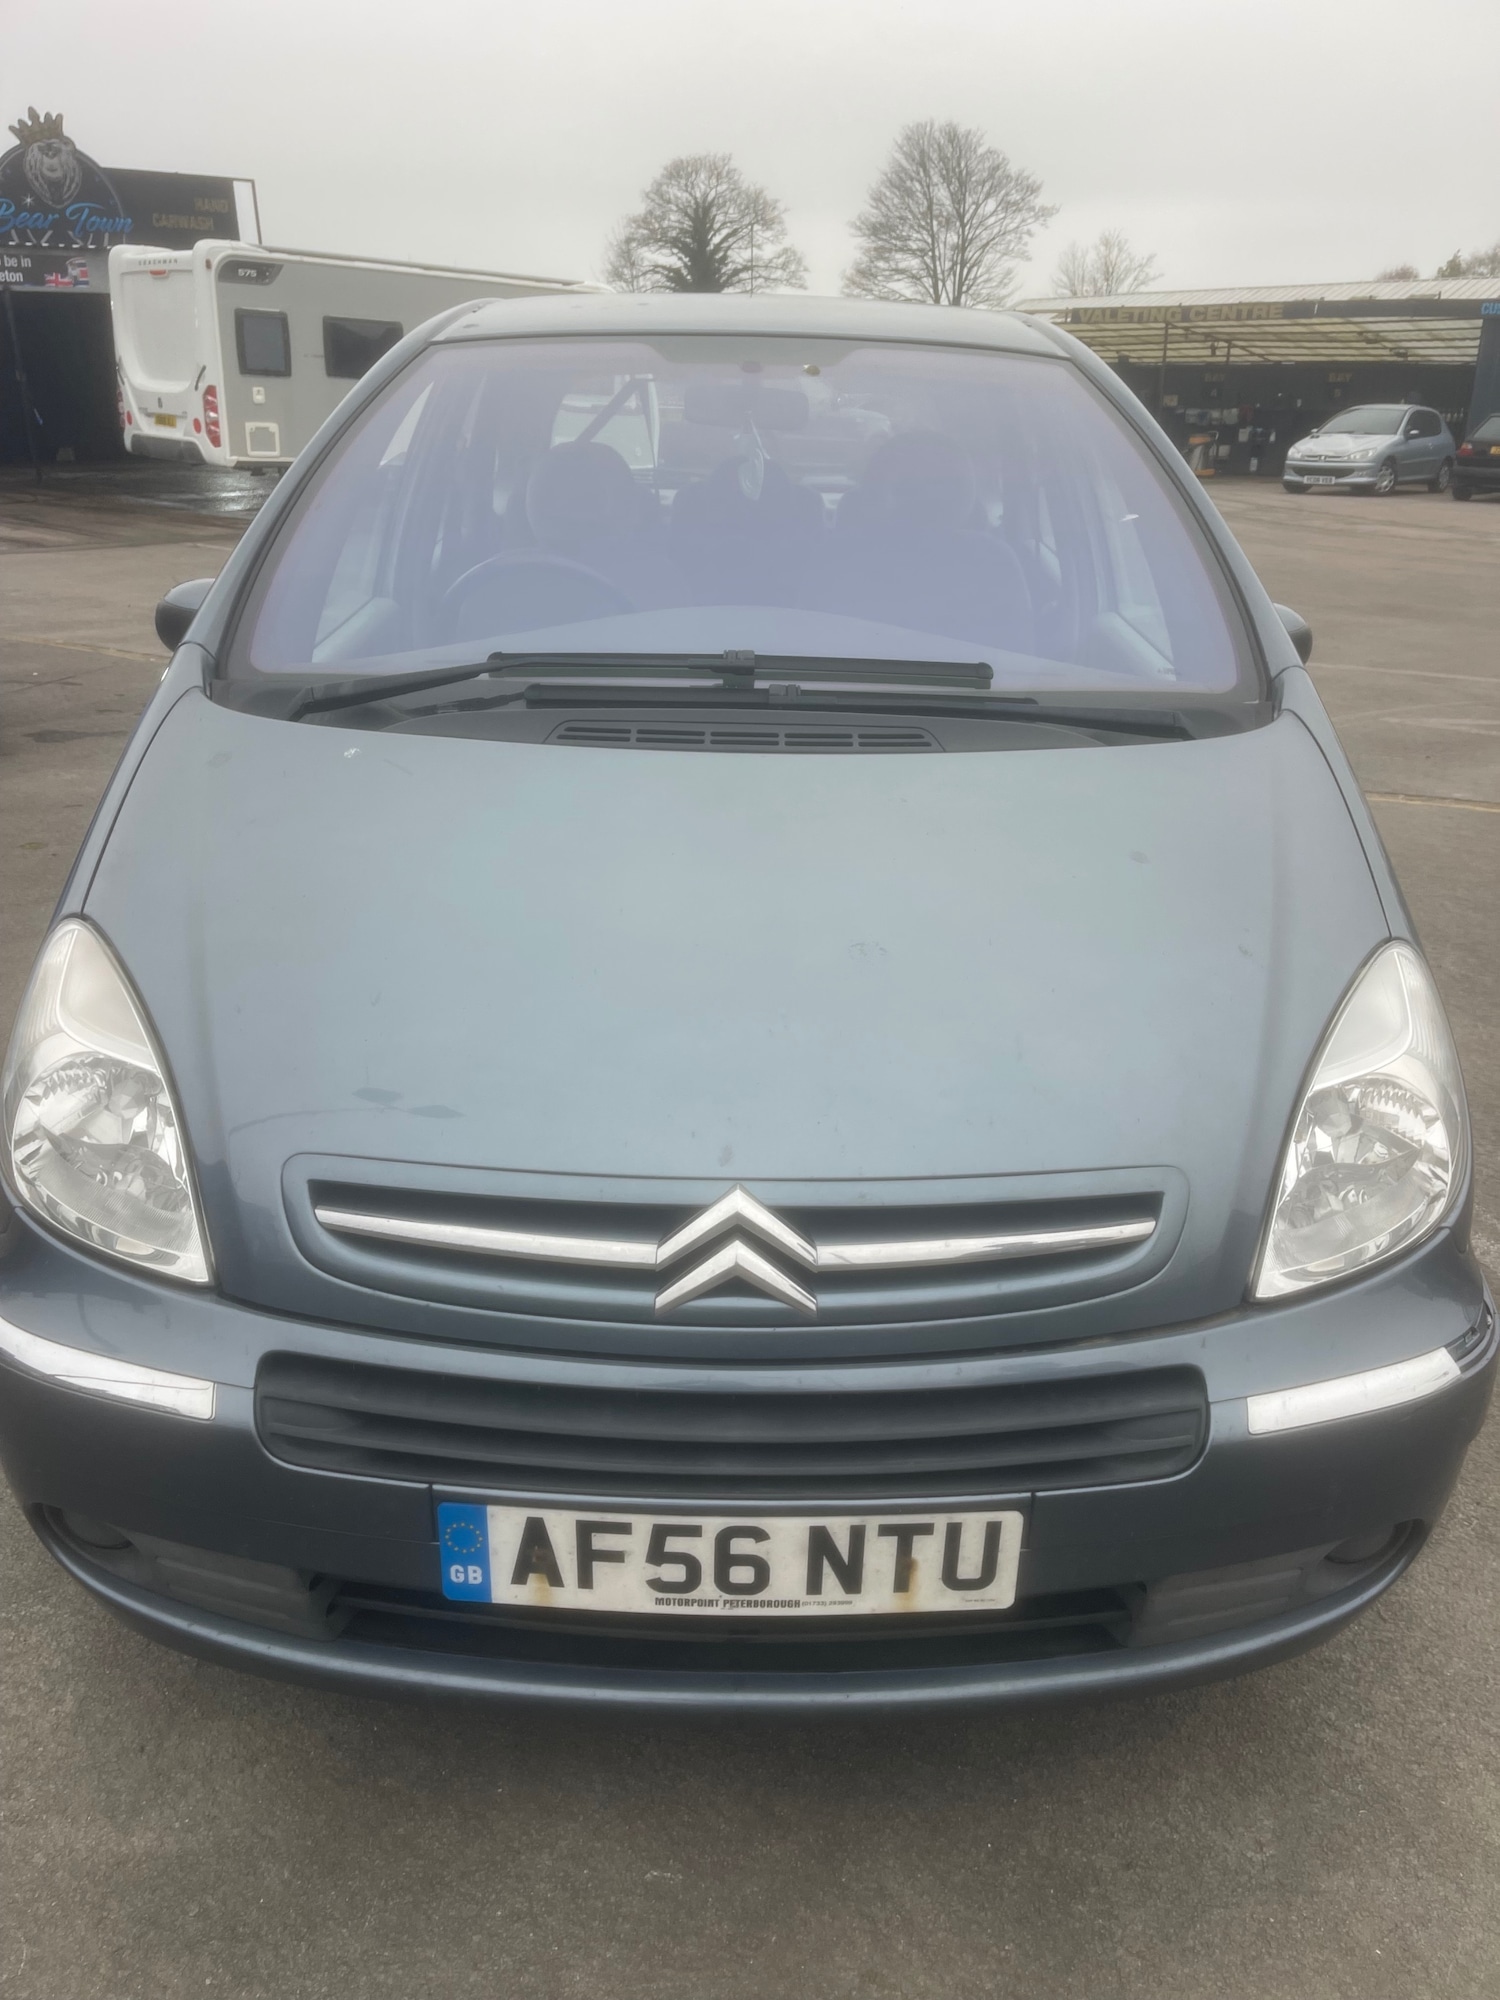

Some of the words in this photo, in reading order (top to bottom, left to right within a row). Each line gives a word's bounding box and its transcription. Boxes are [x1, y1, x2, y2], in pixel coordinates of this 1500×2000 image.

[0, 198, 60, 234] Bear
[66, 202, 134, 238] Town
[4, 255, 18, 267] be
[20, 255, 32, 268] in
[238, 268, 257, 277] 575
[1079, 306, 1183, 323] VALETING
[1189, 304, 1284, 321] CENTRE
[510, 1516, 771, 1596] AF56
[805, 1520, 1003, 1597] NTU
[449, 1564, 483, 1585] GB
[654, 1597, 720, 1607] MOTORPOINT
[723, 1599, 801, 1608] PETERBOROUGH
